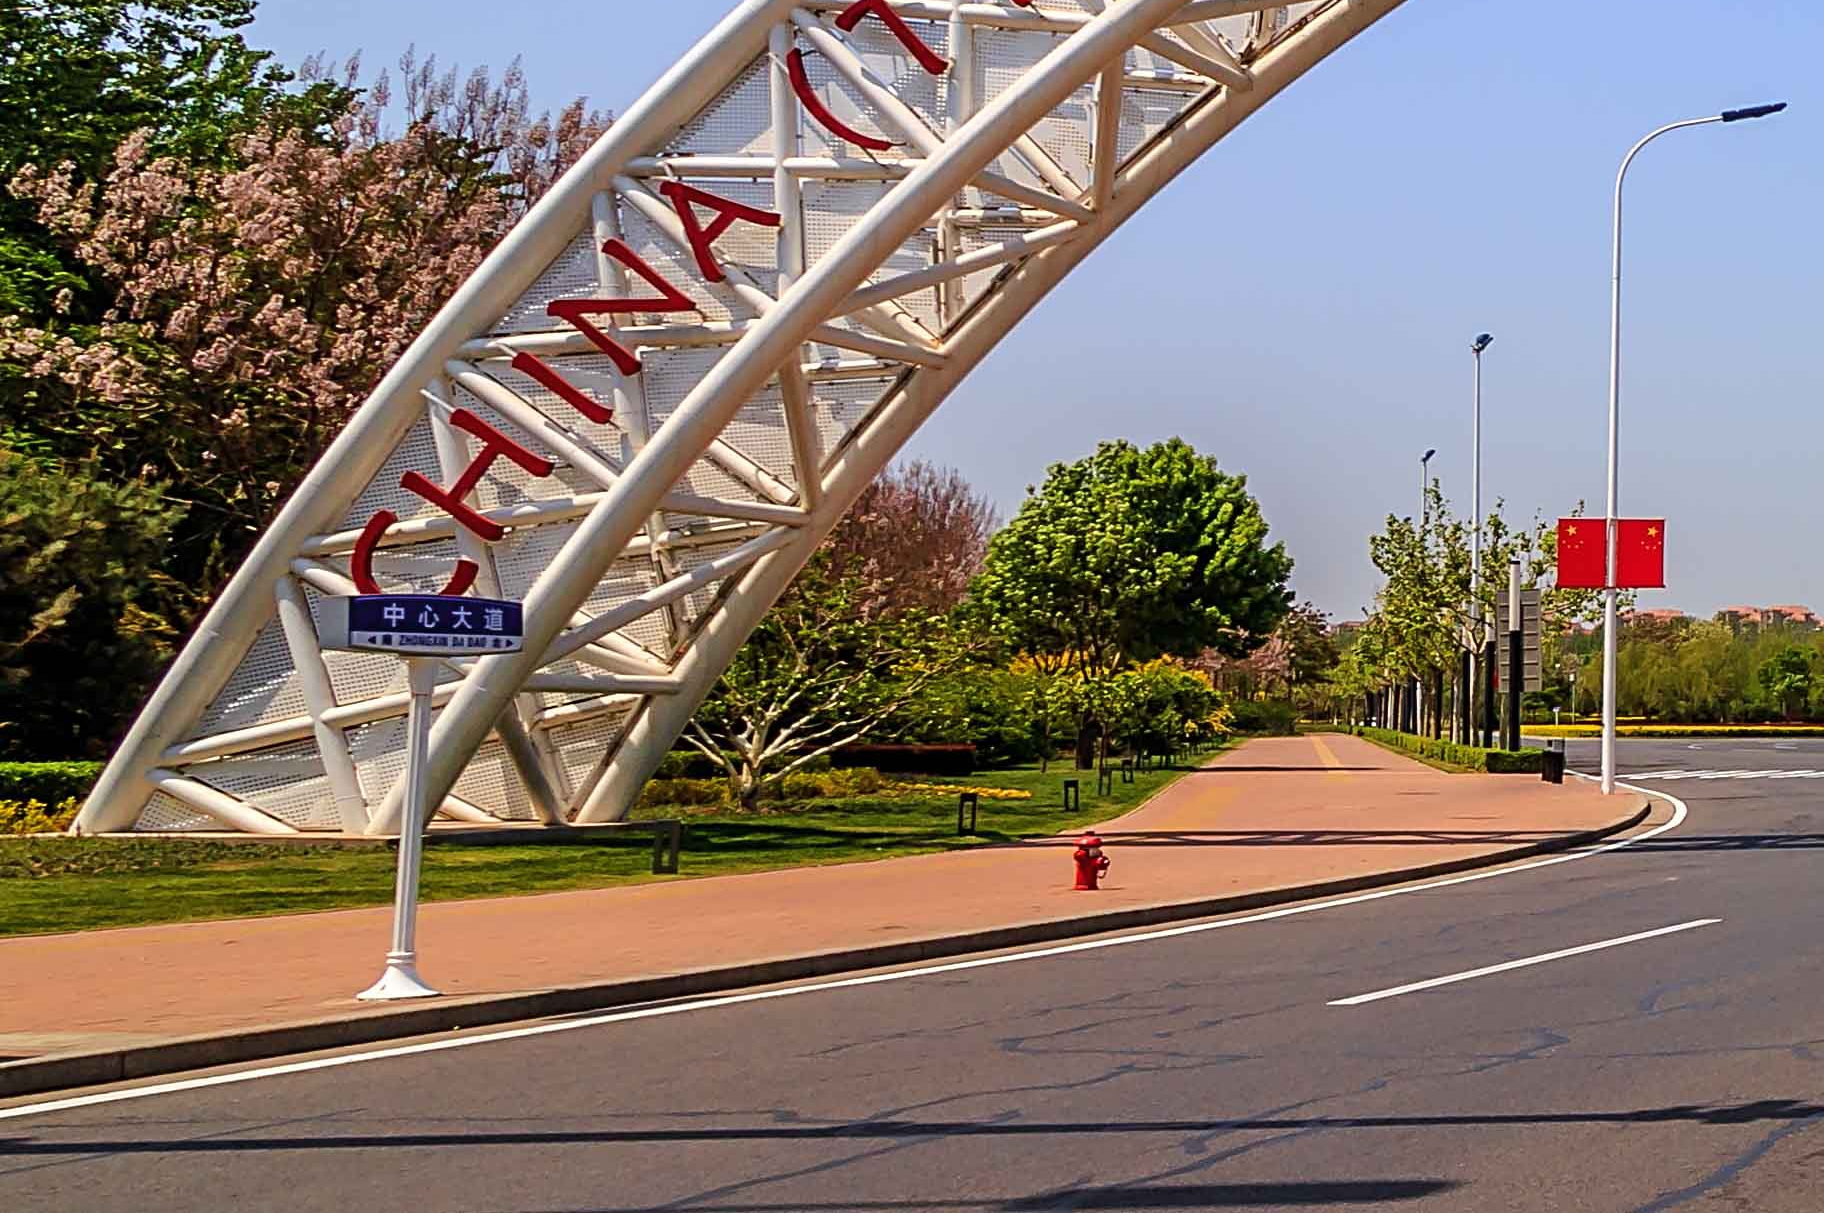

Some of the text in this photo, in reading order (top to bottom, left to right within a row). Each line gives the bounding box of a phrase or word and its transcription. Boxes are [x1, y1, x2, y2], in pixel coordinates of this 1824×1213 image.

[351, 180, 782, 596] CHINA
[383, 603, 504, 631] 中心大道
